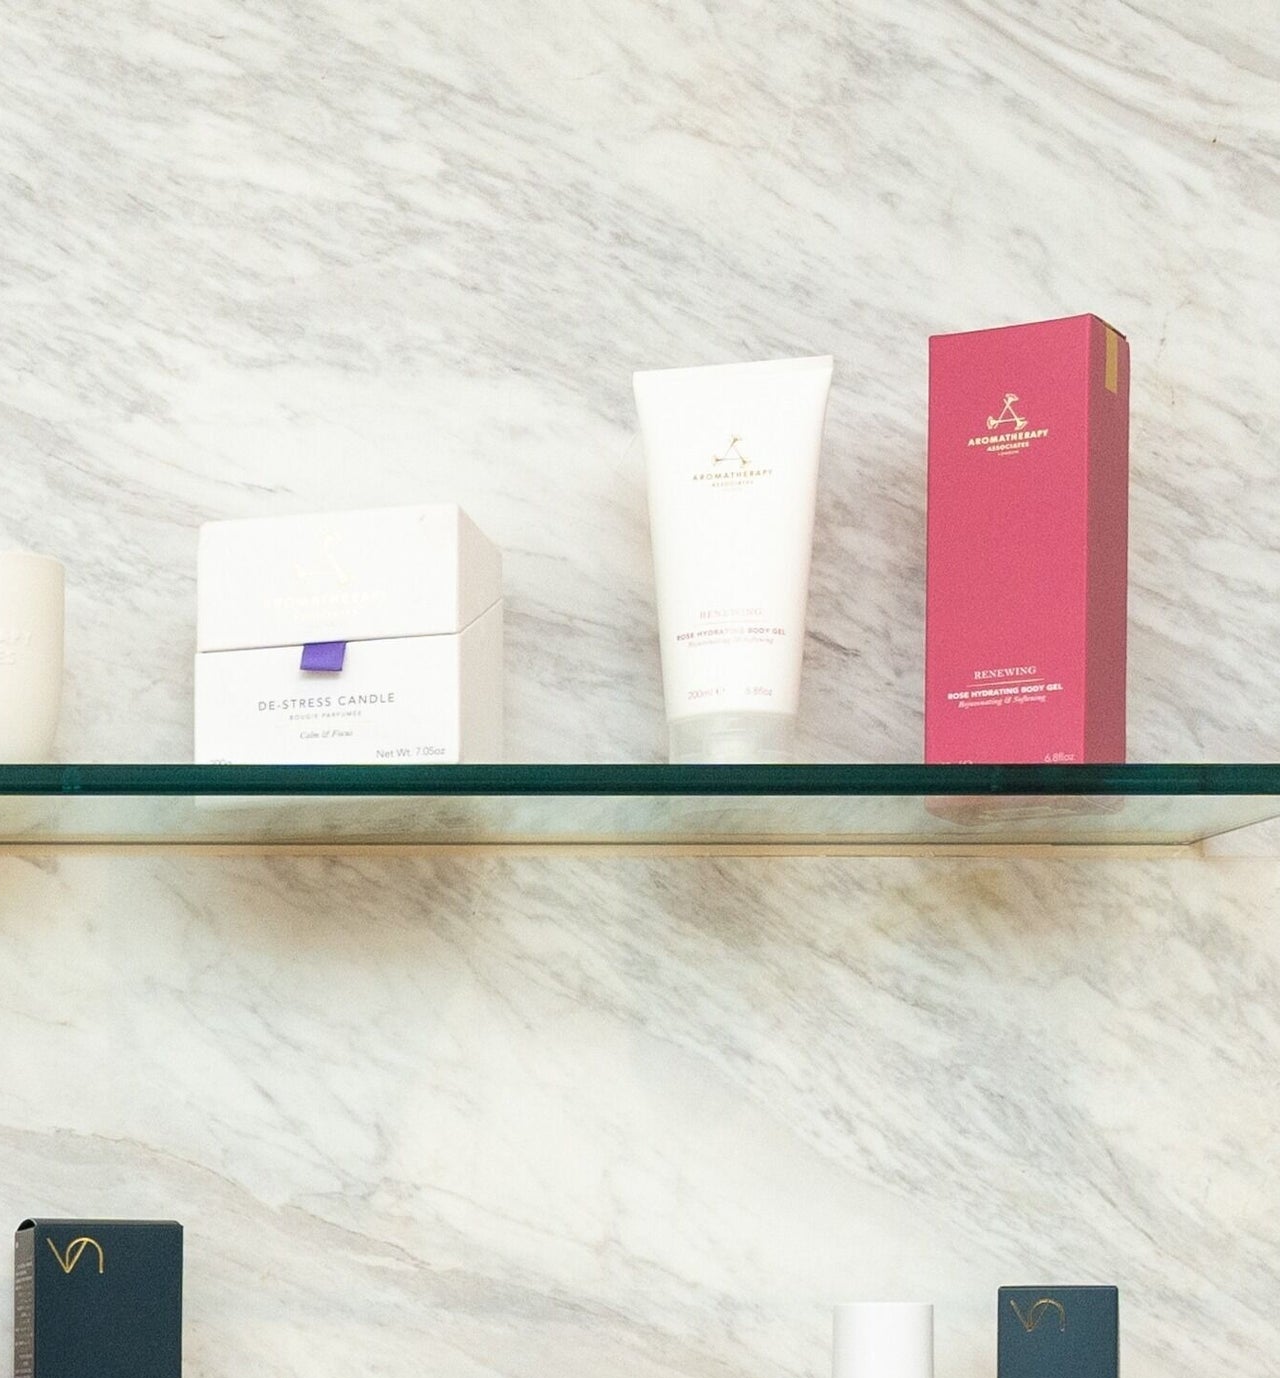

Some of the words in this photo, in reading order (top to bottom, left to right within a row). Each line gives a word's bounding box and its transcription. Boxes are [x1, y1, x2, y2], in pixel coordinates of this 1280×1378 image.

[967, 429, 1049, 446] AROMATHERAPY
[986, 440, 1031, 453] ASSOCIATES
[692, 468, 773, 482] AROMATHERAPY
[974, 665, 1037, 680] RENEWING
[947, 692, 970, 700] ROSE
[971, 687, 1019, 698] HYDRATING
[1021, 684, 1045, 694] BODY
[1046, 683, 1064, 691] GEL
[257, 697, 332, 712] DE-STRESS
[337, 692, 396, 707] CANDLE
